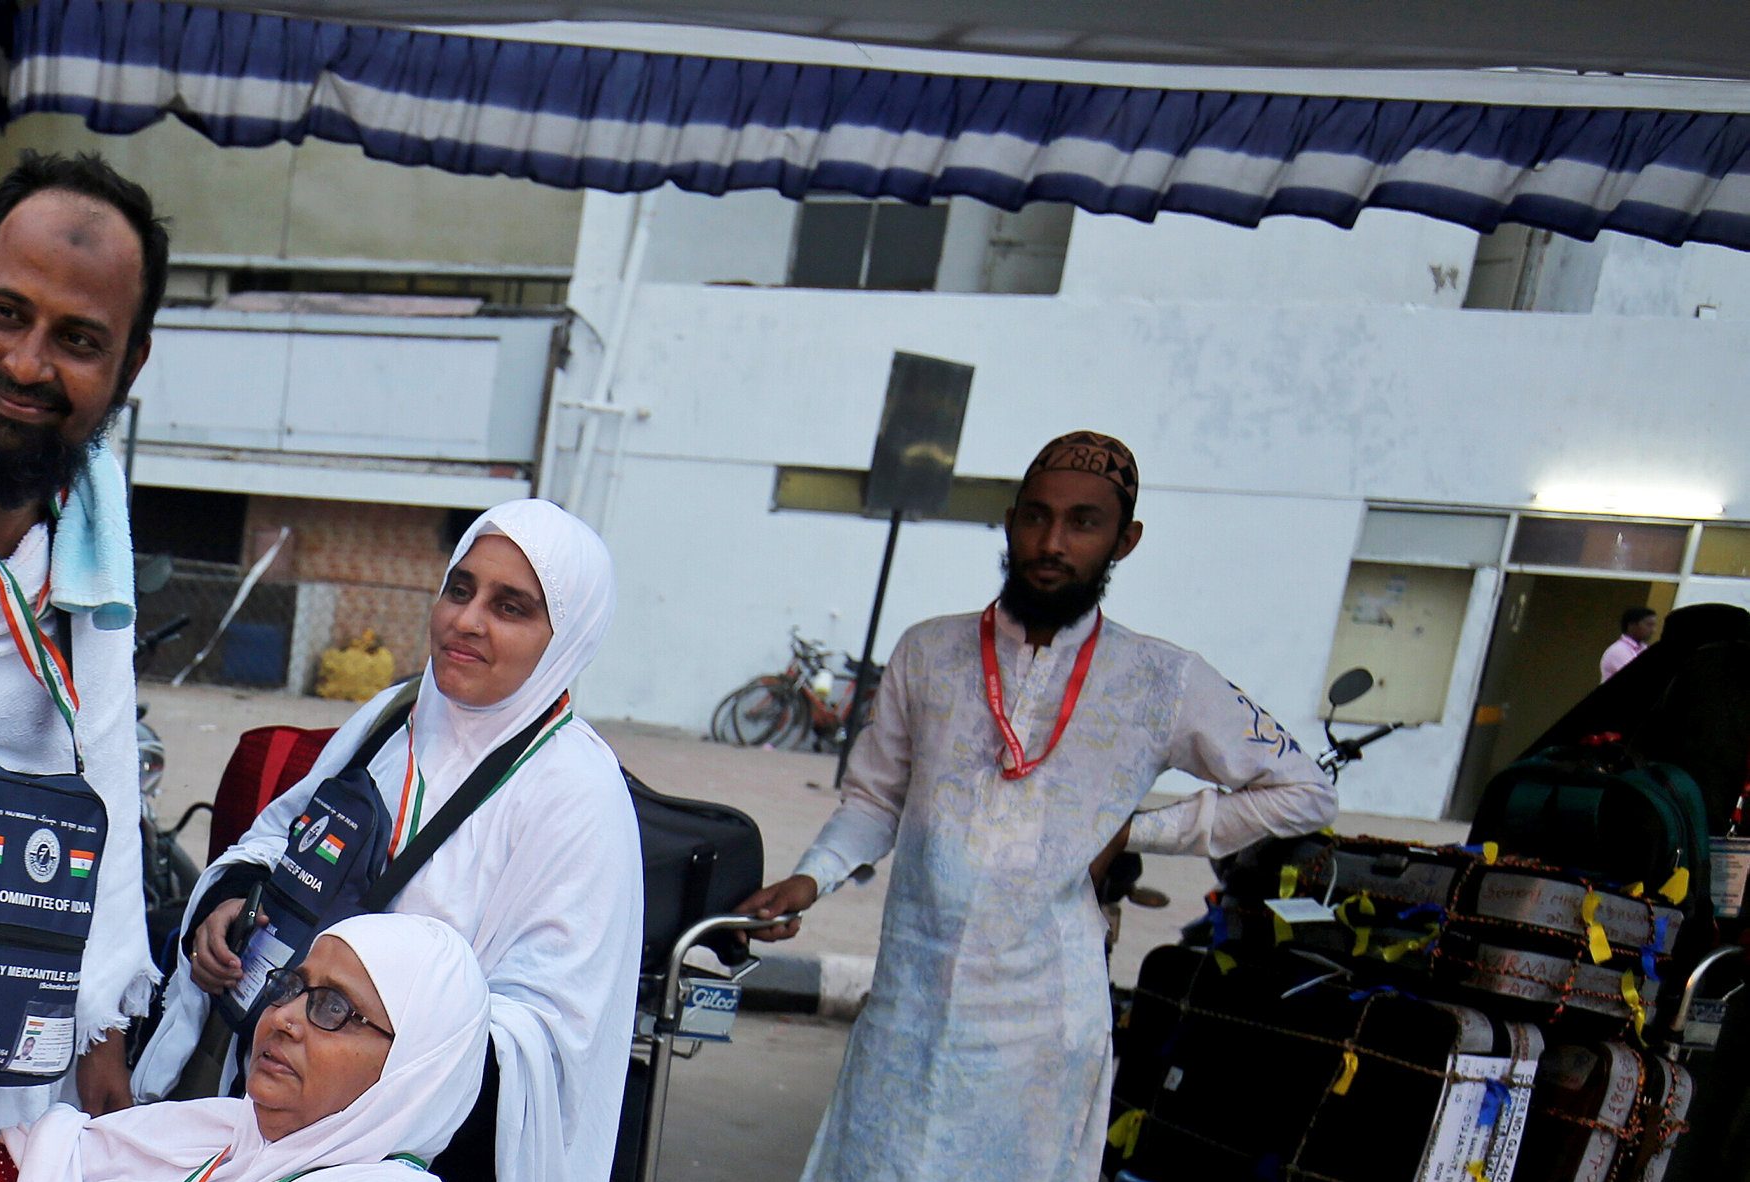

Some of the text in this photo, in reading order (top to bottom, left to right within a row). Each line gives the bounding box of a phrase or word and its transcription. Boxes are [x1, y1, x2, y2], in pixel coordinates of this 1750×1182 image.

[297, 869, 323, 892] INDIA
[55, 899, 70, 912] OF
[7, 966, 67, 981] MERCANTILE
[1518, 1073, 1532, 1113] CVER
